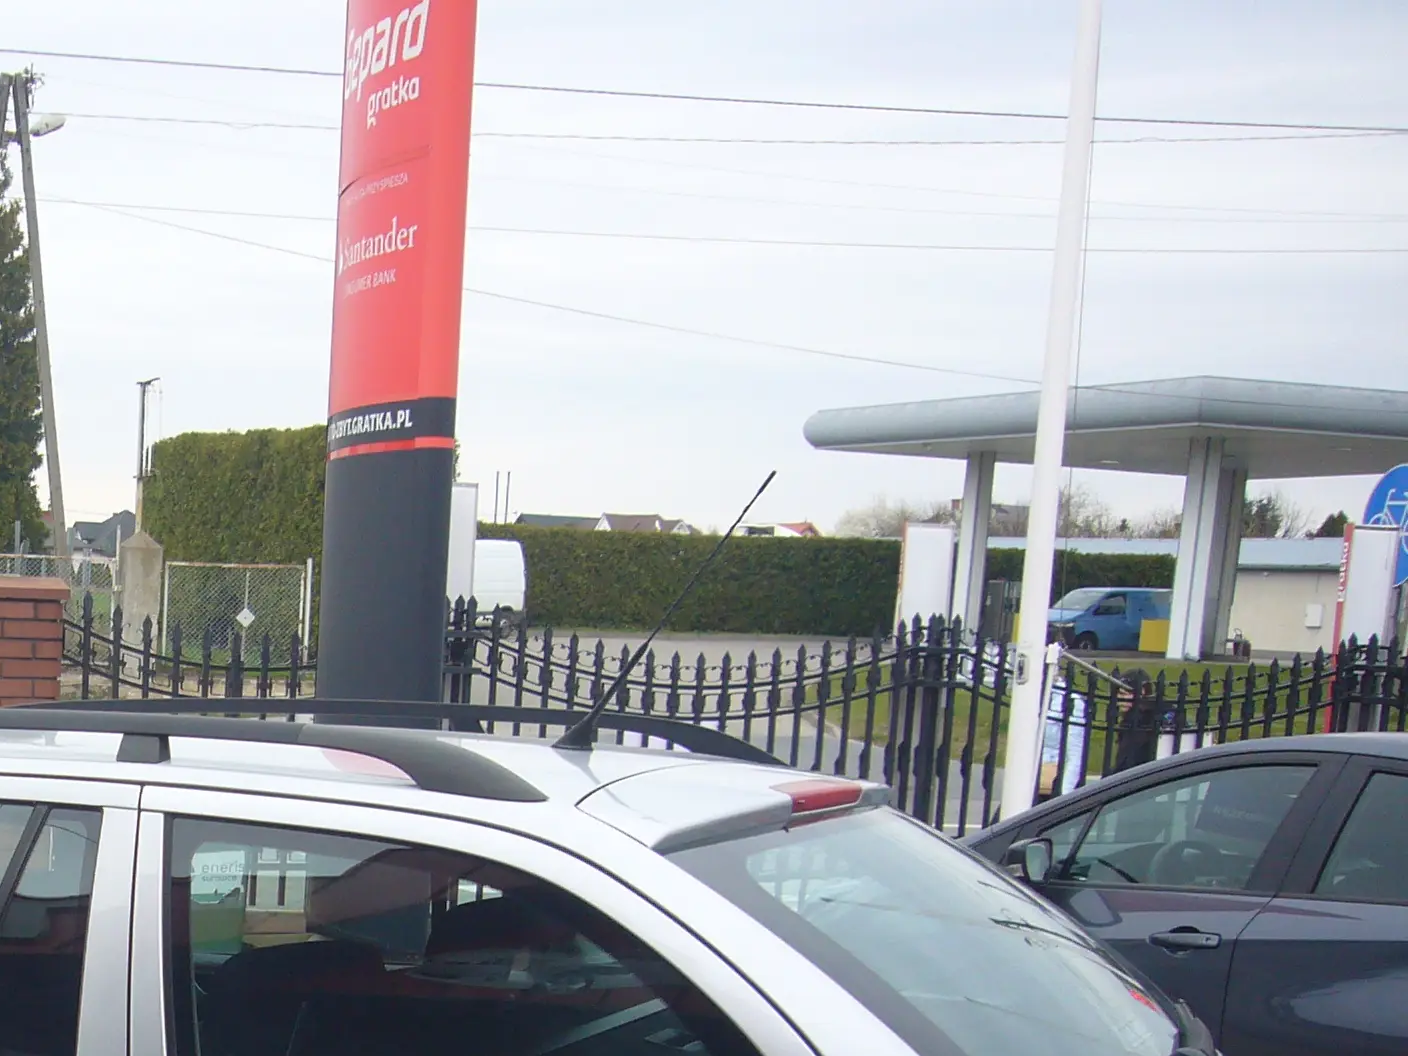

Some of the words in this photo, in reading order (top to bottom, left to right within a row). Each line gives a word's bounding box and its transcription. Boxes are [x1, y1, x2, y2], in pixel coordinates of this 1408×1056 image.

[366, 75, 421, 130] gratka
[343, 216, 419, 271] Santander
[372, 268, 397, 288] BANK
[201, 860, 245, 873] eneris
